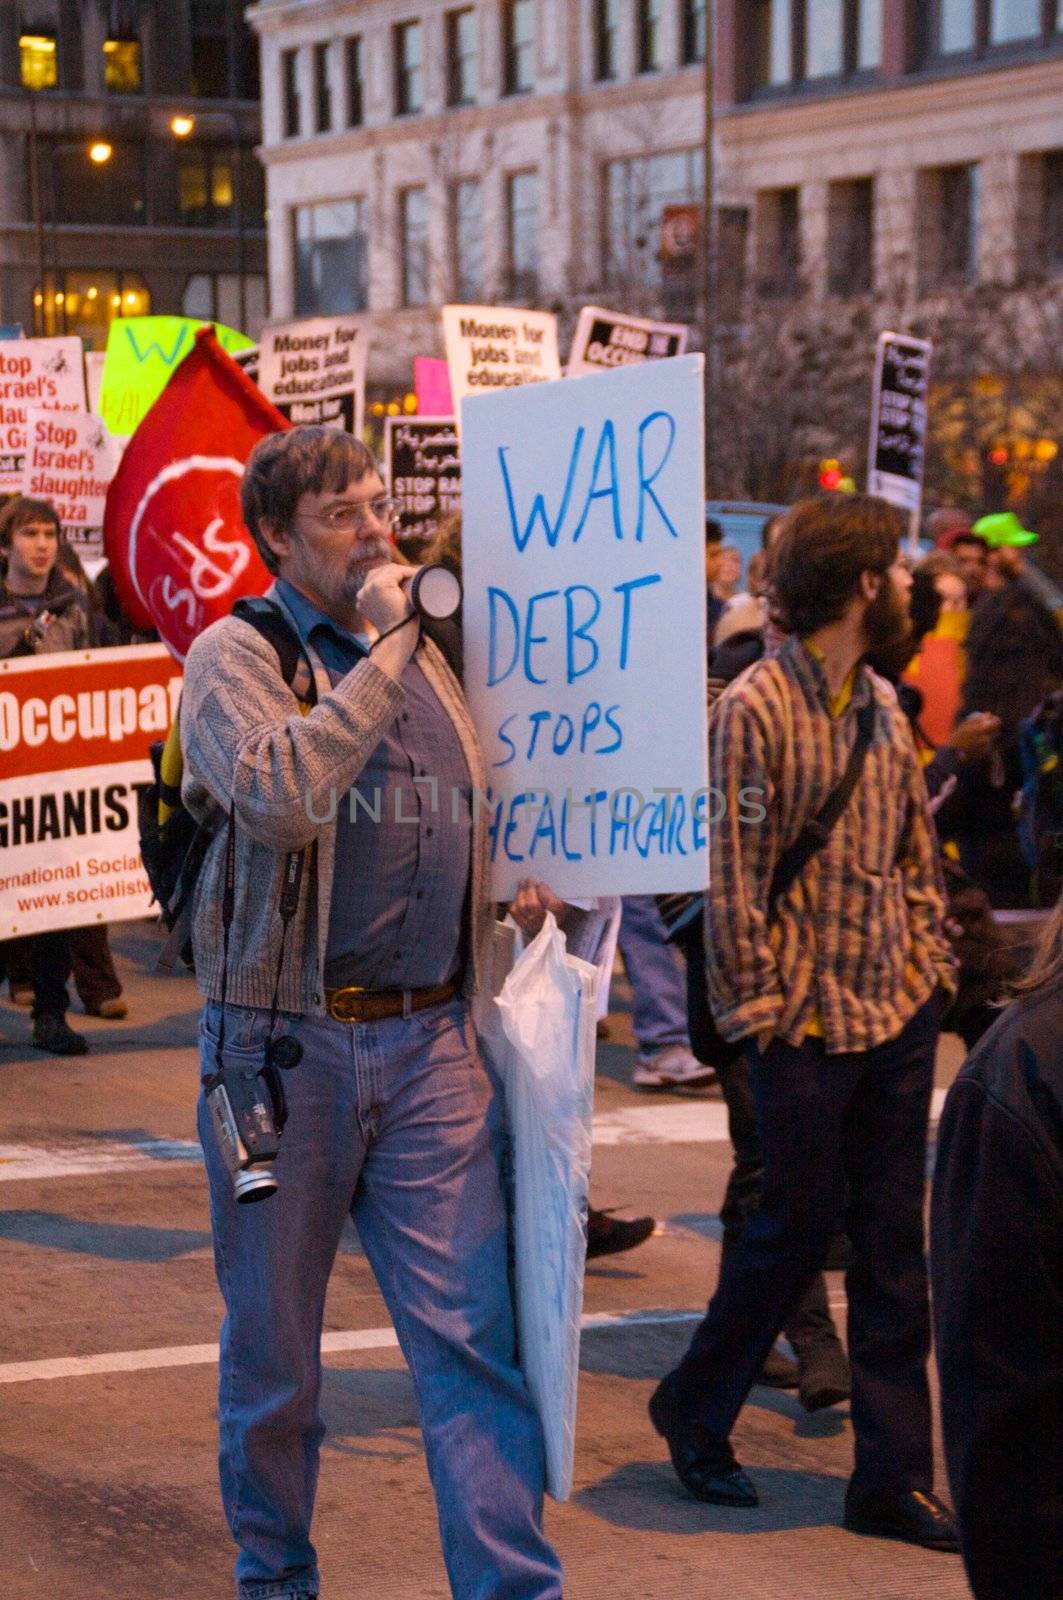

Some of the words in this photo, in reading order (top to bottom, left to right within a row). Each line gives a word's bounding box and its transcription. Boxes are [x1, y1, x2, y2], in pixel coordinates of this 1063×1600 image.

[274, 333, 330, 352] Money
[335, 325, 359, 344] for
[460, 319, 517, 345] Money
[522, 322, 545, 342] for
[281, 353, 319, 378] jobs
[324, 346, 349, 369] and
[471, 342, 509, 367] jobs
[274, 369, 354, 396] education
[34, 419, 77, 449] Stop
[32, 446, 95, 471] Israel's
[498, 410, 679, 552] WAR
[487, 573, 662, 687] DEBT
[492, 701, 623, 768] STOPS
[487, 787, 707, 862] HEALTHCARE
